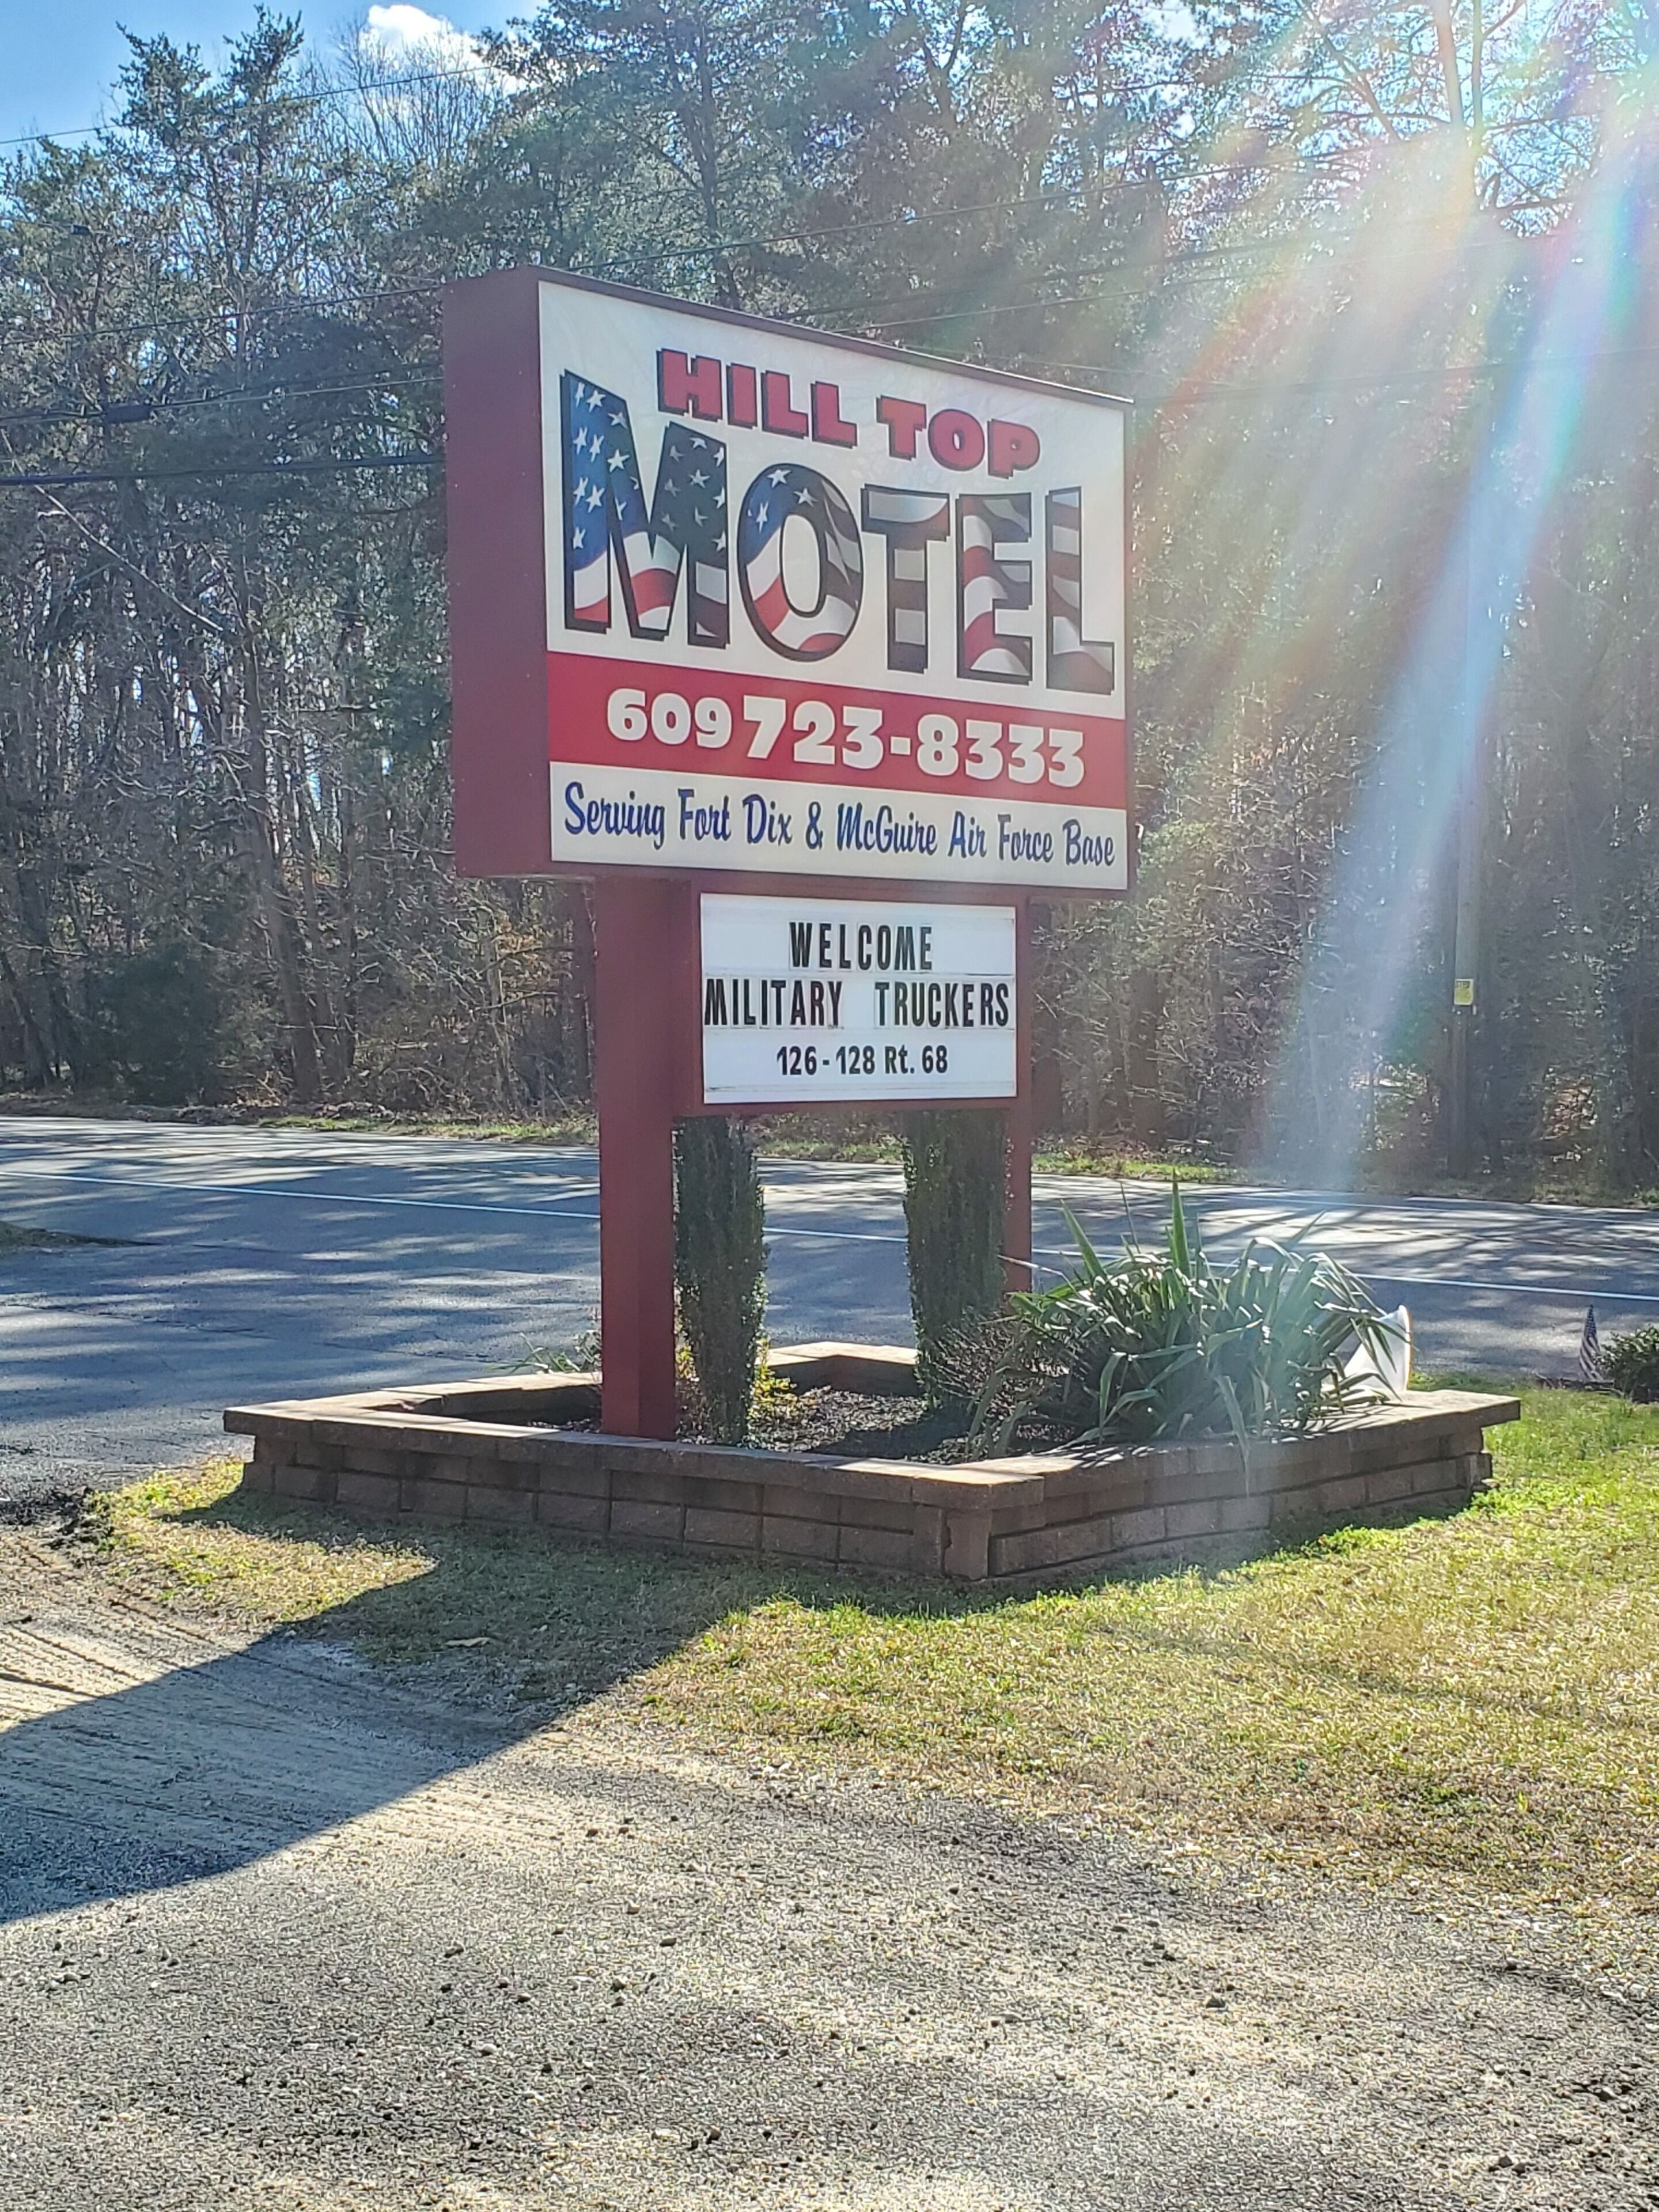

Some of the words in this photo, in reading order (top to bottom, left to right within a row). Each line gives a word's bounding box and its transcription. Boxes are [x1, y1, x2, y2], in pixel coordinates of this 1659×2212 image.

[657, 348, 857, 448] HILL
[876, 395, 1040, 478] TOP
[559, 369, 1114, 694] MOTEL
[607, 688, 732, 748] 609
[743, 695, 1084, 788] 723-8333
[564, 781, 665, 850] Serving
[677, 787, 732, 842] Fort
[742, 794, 793, 844] Dix
[805, 802, 823, 850] &
[835, 802, 938, 856] McGuire
[946, 810, 987, 859] Air
[997, 813, 1054, 863] Force
[1062, 819, 1116, 867] Base
[789, 922, 933, 971] WELCOME
[704, 978, 842, 1027] MILITARY
[874, 982, 1009, 1028] TRUCKERS
[884, 1044, 915, 1074] Rt.
[922, 1045, 948, 1074] 68
